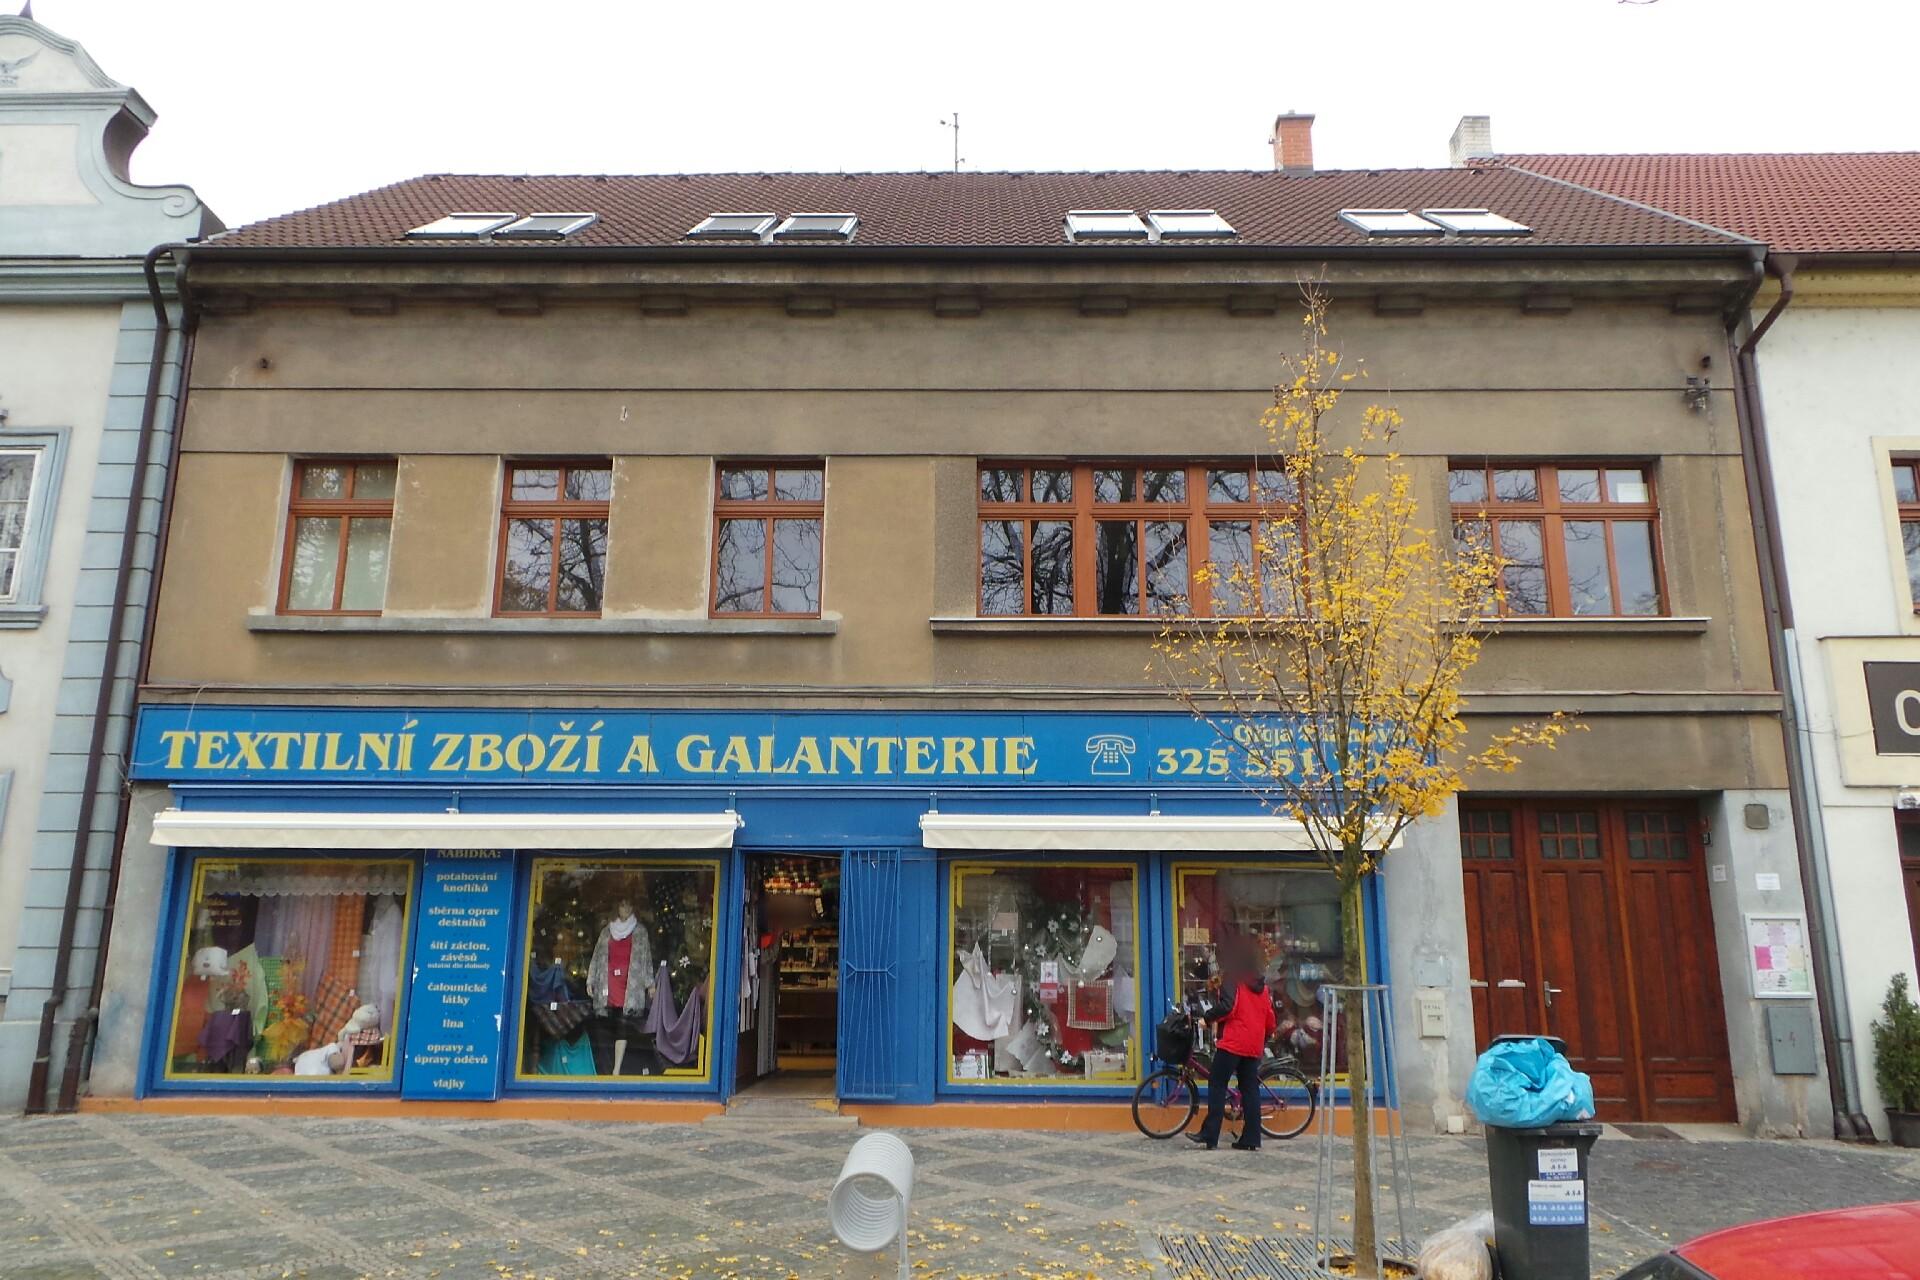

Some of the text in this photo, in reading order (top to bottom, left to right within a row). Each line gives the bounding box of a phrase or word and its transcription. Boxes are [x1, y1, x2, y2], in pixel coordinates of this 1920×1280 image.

[159, 719, 1038, 775] TEXTILNÍ ZBOŽÍ A GALANTERIE
[1156, 748, 1229, 776] 325
[1245, 747, 1318, 777] 551
[436, 873, 497, 882] potahování
[443, 883, 488, 893] knoflíků
[428, 906, 499, 917] sběrna oprav
[438, 918, 486, 928] deštníků
[430, 941, 490, 951] šití záclon,
[441, 953, 477, 962] závěsů
[427, 982, 488, 993] čalounické
[442, 995, 470, 1006] látky
[427, 1044, 474, 1053] opravy a
[414, 1055, 488, 1065] úpravy oděvů
[433, 1079, 465, 1089] vlajky
